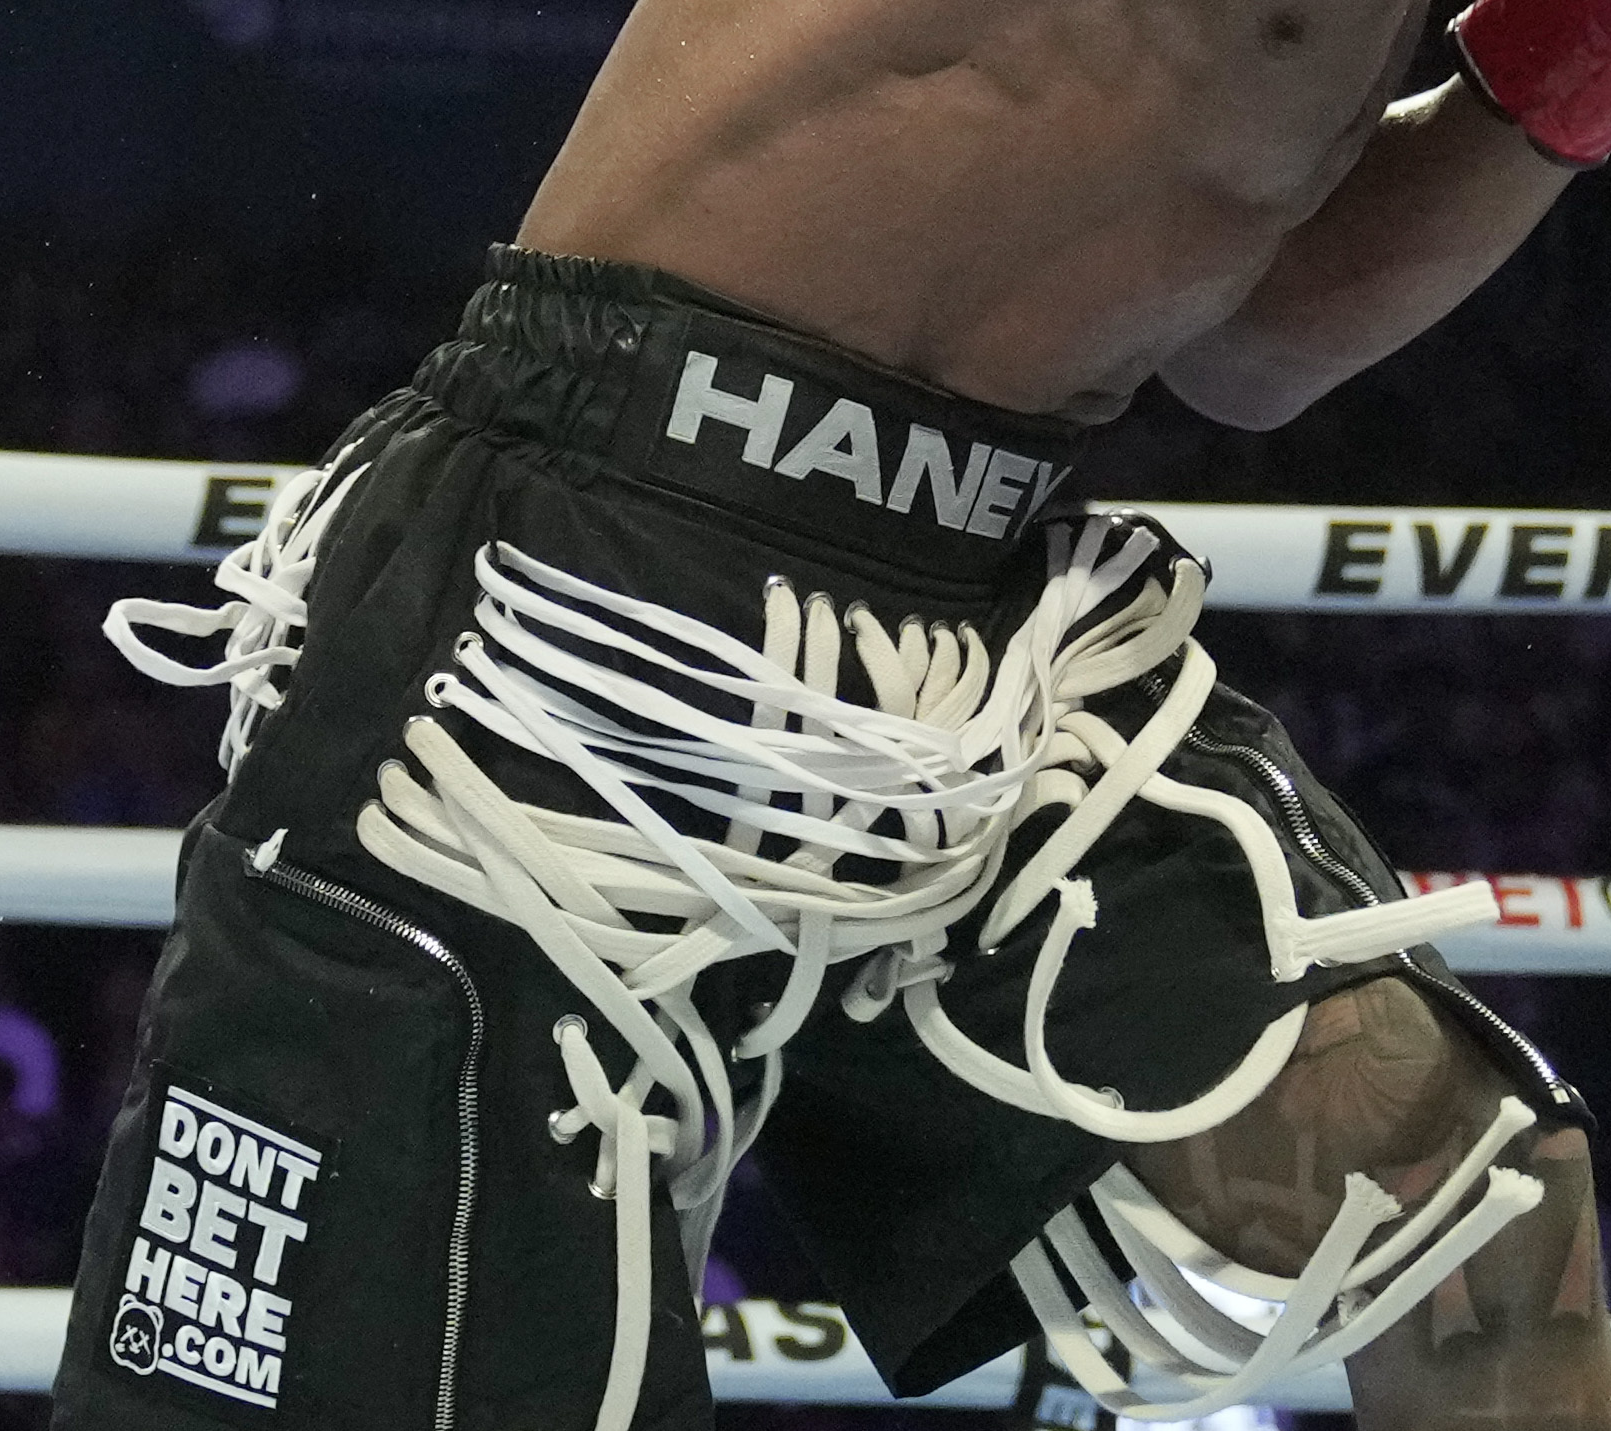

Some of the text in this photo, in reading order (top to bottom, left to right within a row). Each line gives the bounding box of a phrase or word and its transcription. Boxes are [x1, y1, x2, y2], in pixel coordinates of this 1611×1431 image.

[665, 350, 1074, 541] HANEY
[158, 1100, 320, 1210] DONT
[139, 1155, 308, 1287] BET
[124, 1235, 293, 1343] HERE
[160, 1324, 283, 1394] .COM
